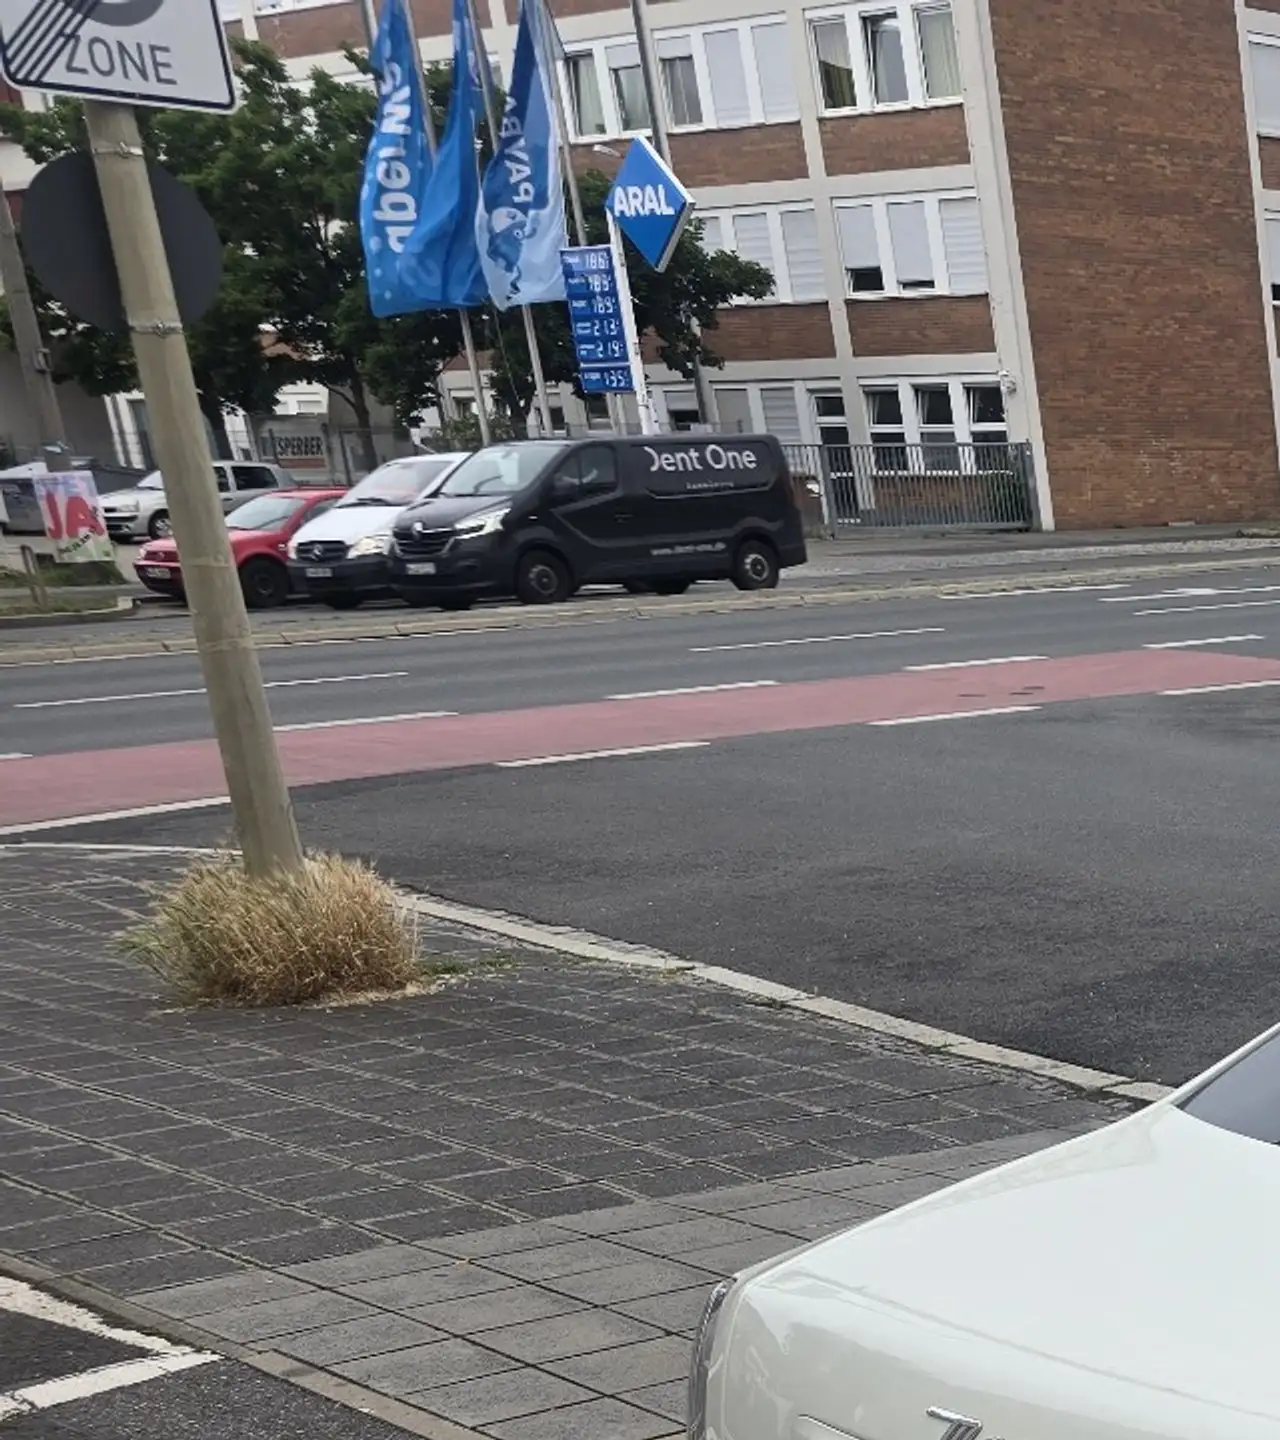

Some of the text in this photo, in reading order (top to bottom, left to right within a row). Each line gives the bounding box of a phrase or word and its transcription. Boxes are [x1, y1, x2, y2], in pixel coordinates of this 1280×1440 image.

[65, 34, 178, 85] ZONE
[614, 184, 676, 217] ARAL
[276, 436, 323, 456] SPERBER
[706, 444, 757, 470] One
[46, 491, 105, 540] JA
